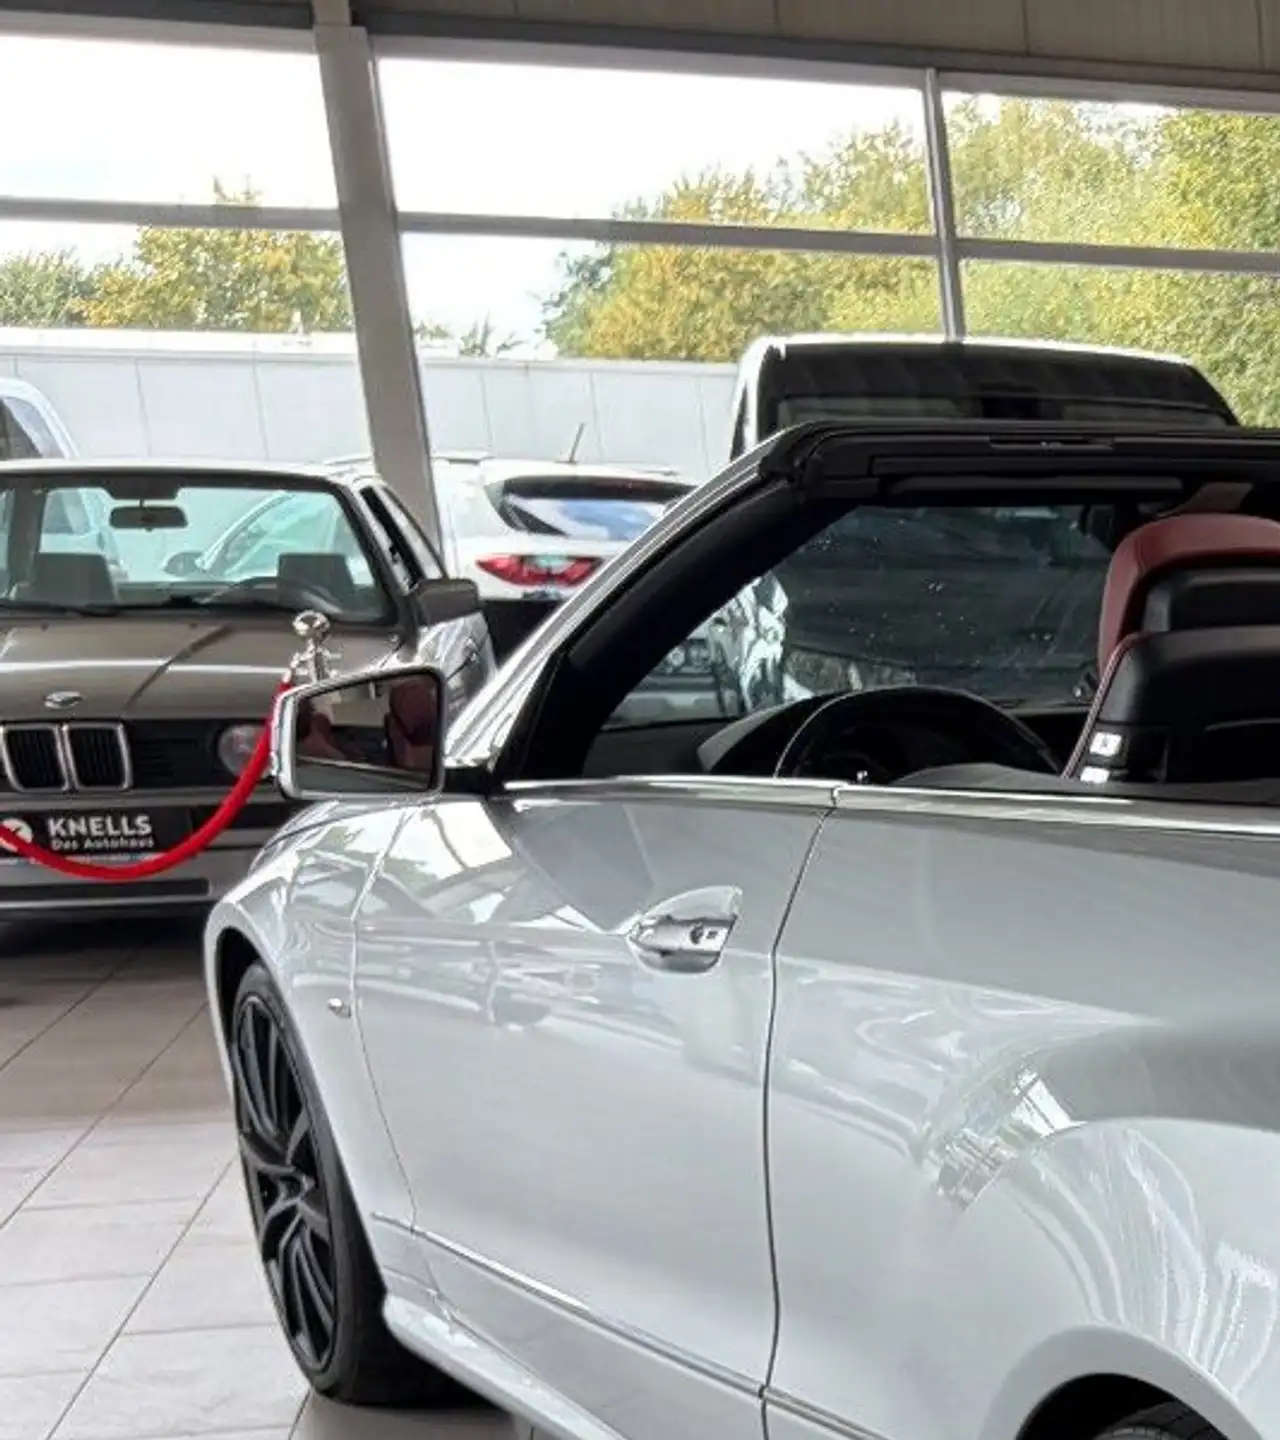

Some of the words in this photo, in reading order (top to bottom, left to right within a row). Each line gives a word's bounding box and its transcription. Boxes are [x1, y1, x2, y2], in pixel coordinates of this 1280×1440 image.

[47, 815, 153, 837] KNELLS
[51, 838, 79, 851] Das
[84, 836, 154, 850] Autohaus
